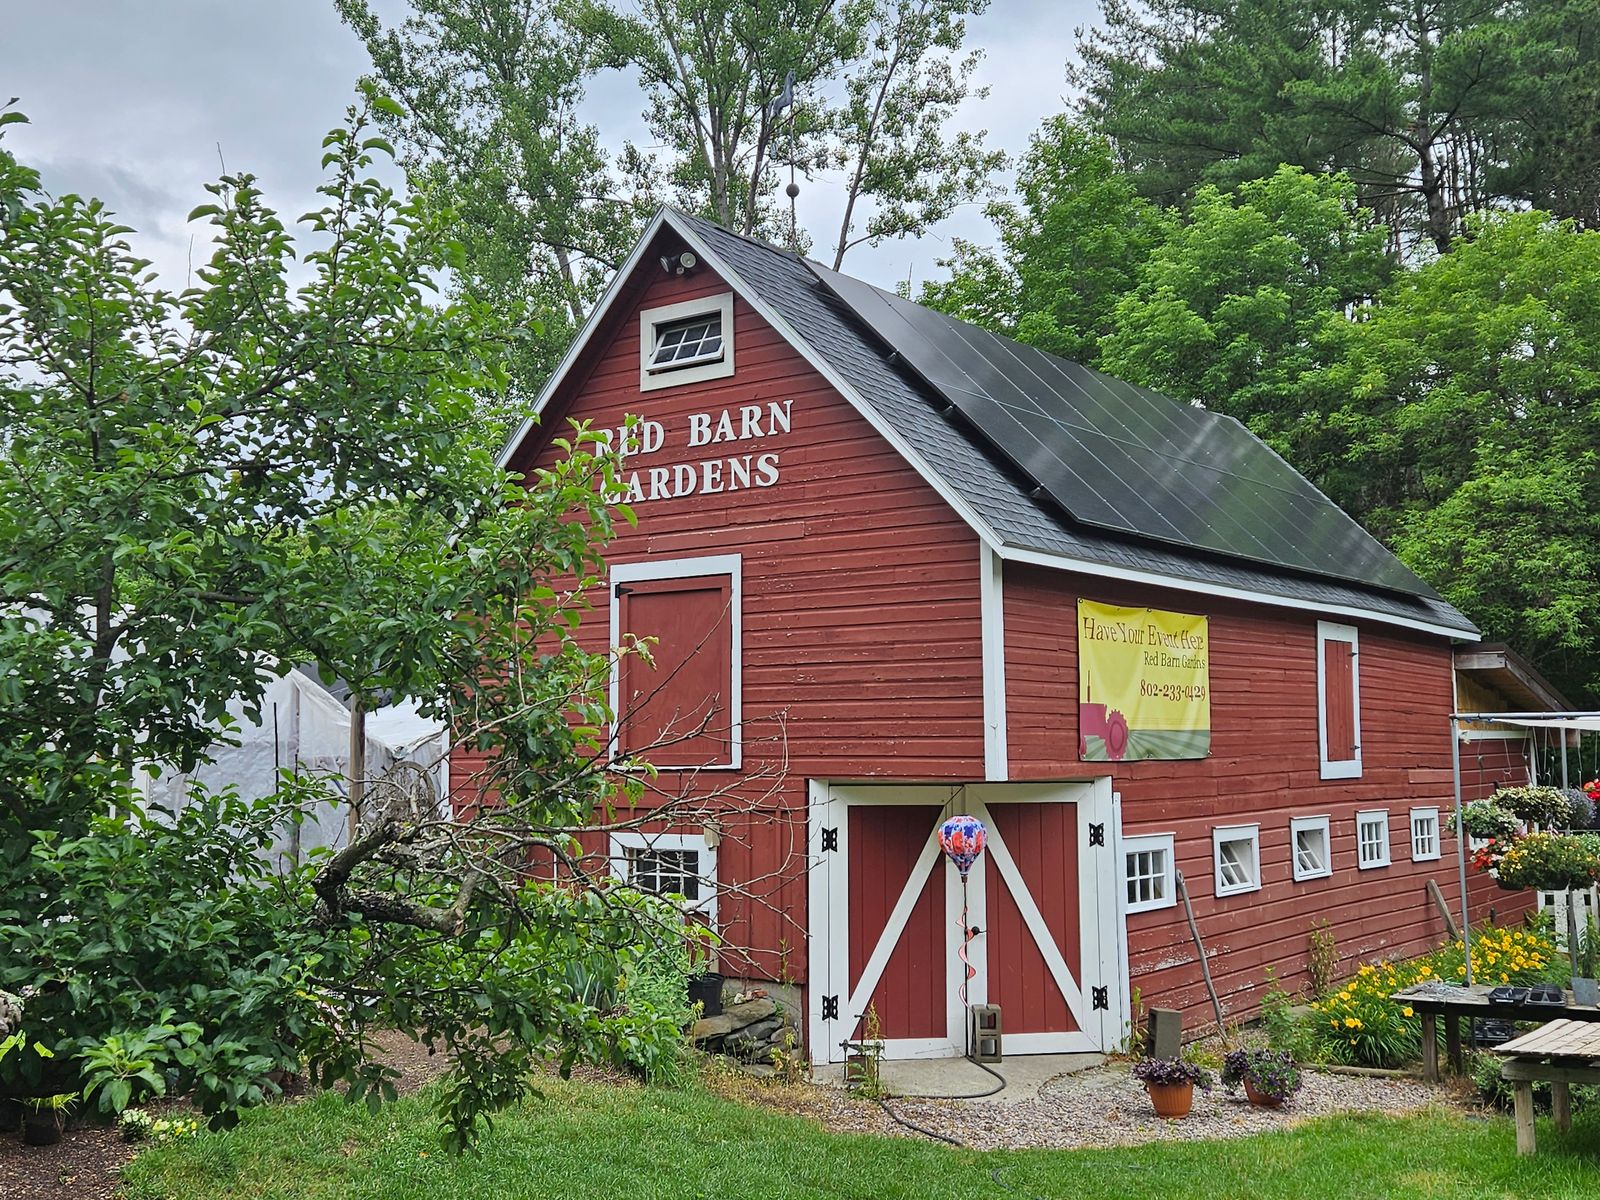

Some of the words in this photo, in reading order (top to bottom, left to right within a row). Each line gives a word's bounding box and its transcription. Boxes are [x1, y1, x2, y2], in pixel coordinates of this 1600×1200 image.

[688, 400, 794, 447] BARN
[1083, 617, 1117, 642] Have
[1117, 622, 1145, 645] Your
[1148, 625, 1179, 649] Event
[1144, 651, 1159, 667] Red
[1161, 653, 1181, 668] Barn
[1140, 679, 1206, 702] 802-233-0429
